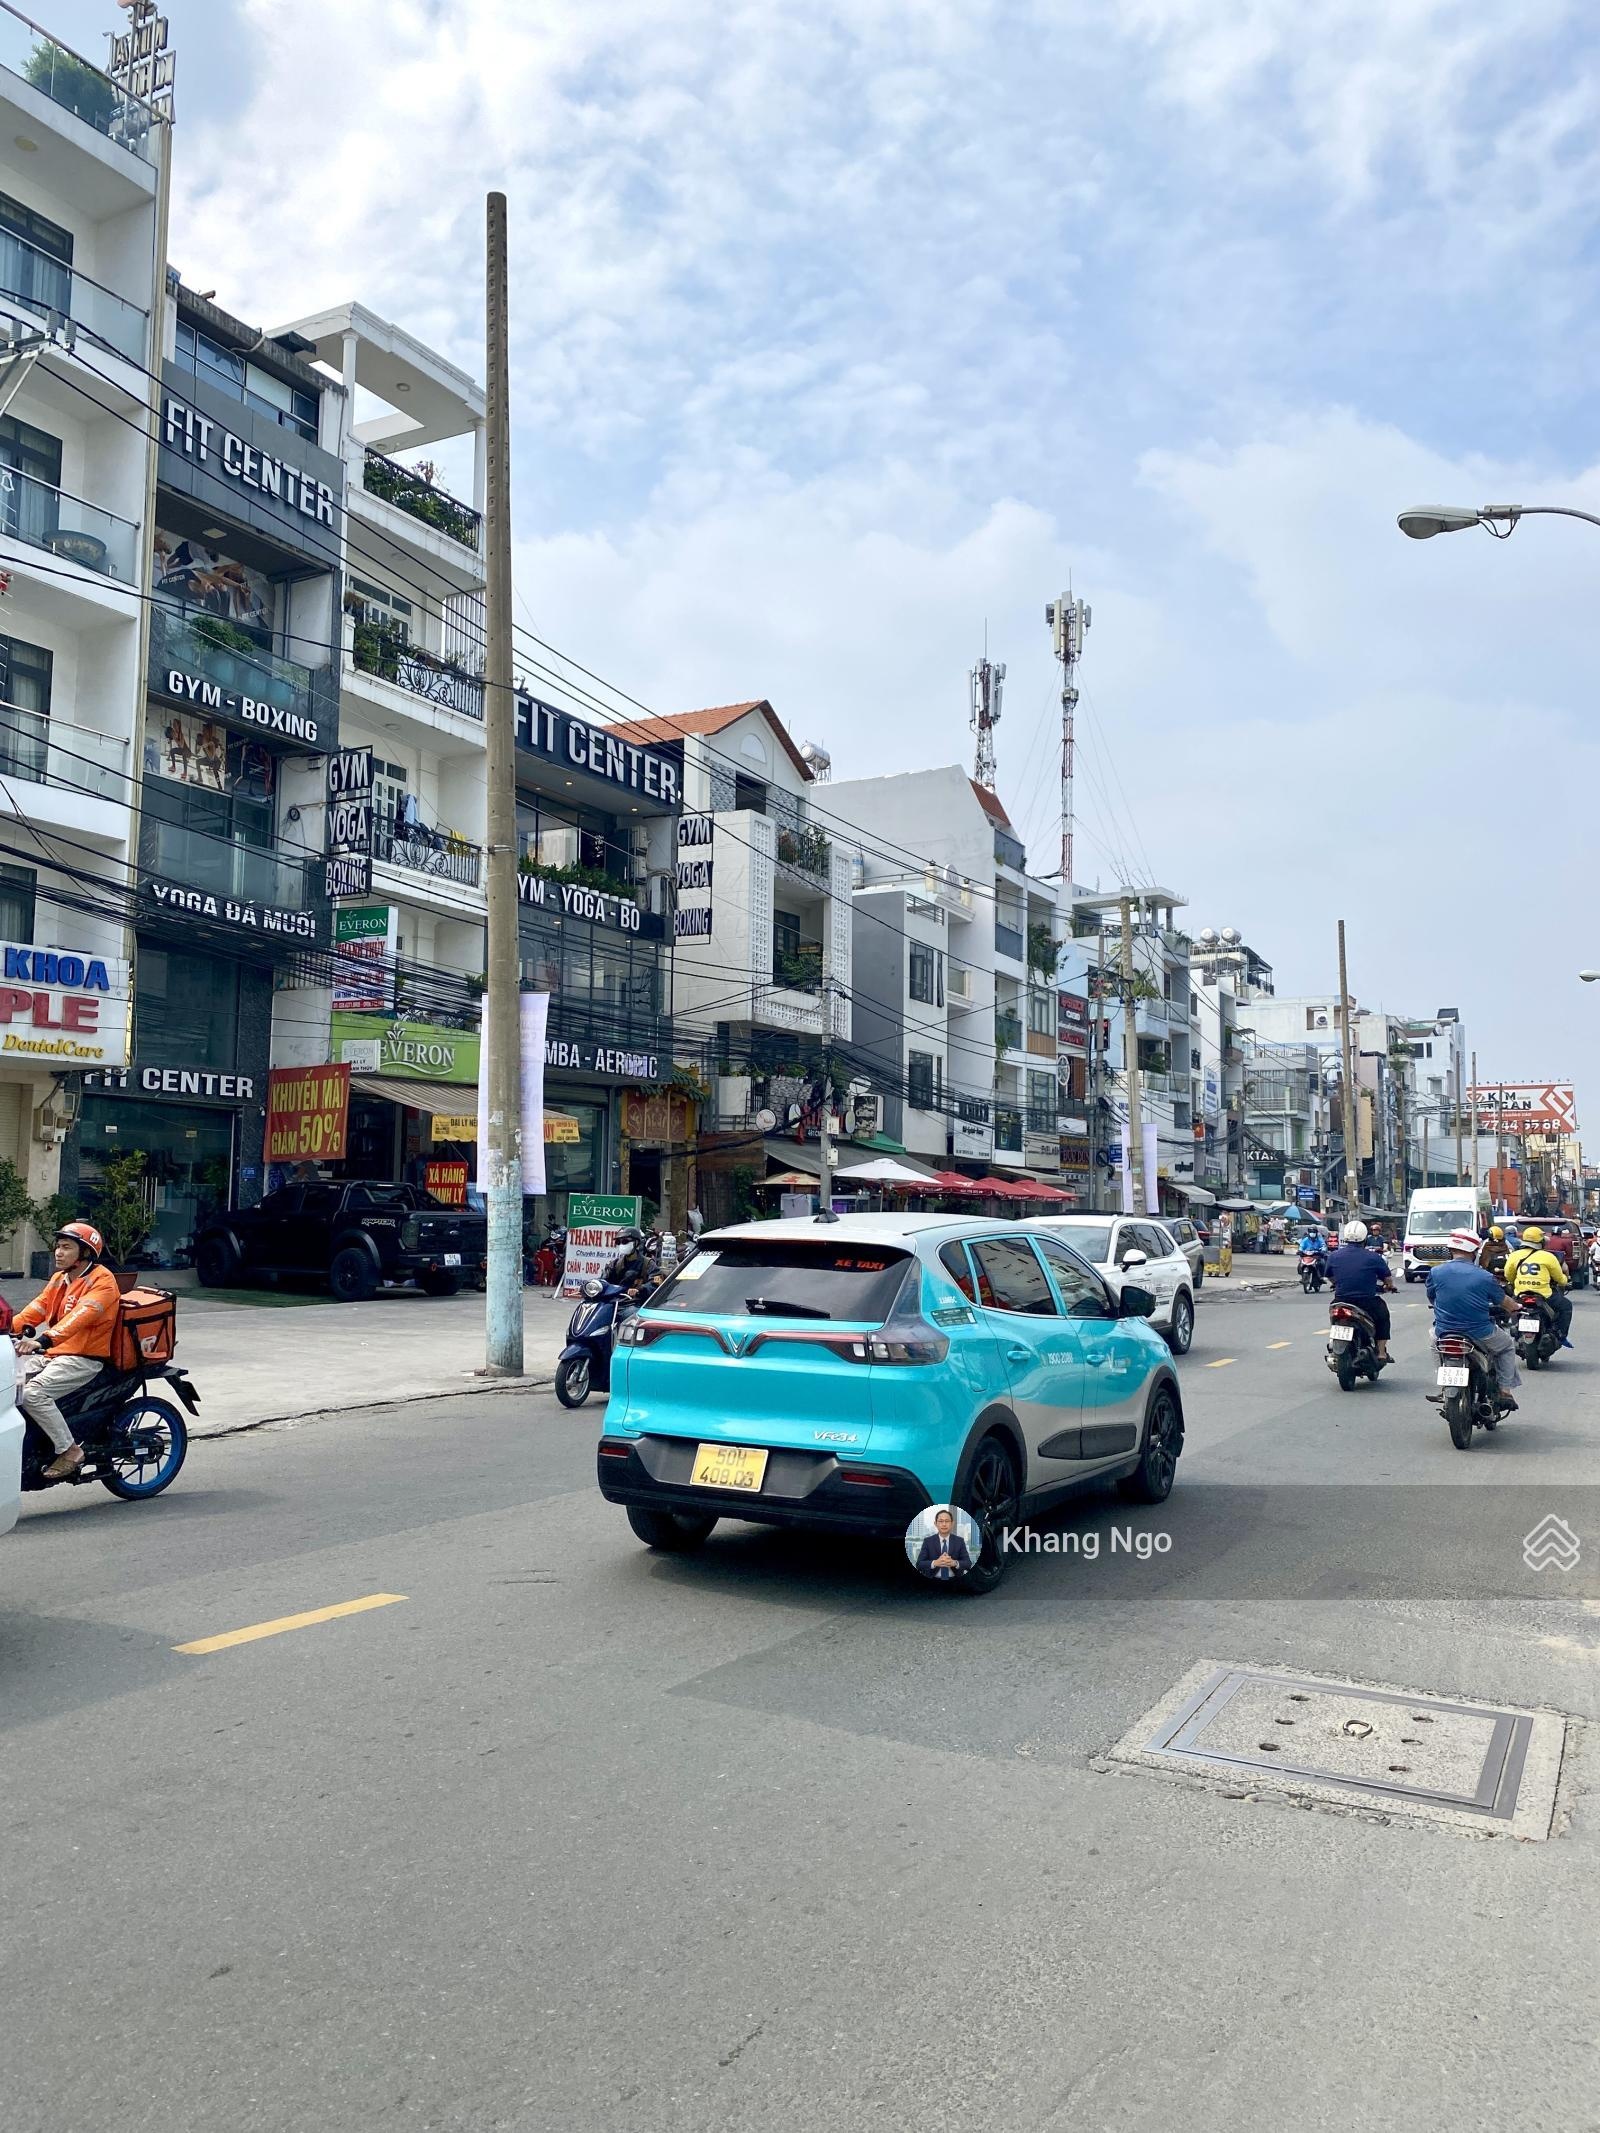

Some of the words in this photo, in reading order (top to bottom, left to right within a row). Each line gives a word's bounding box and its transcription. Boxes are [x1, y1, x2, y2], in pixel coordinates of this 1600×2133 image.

[167, 399, 213, 461] FIT
[224, 432, 333, 526] CENTER
[168, 670, 221, 708] GYM
[242, 696, 318, 742] BOXING
[513, 694, 560, 753] FIT
[568, 720, 677, 805] CENTER
[329, 752, 369, 792] GYM
[328, 807, 368, 844] YOGA
[676, 817, 711, 846] GYM
[325, 858, 367, 896] BOXING
[676, 860, 709, 889] YOGA
[153, 884, 218, 917] YOGA
[225, 900, 257, 926] ĐÁ
[263, 909, 316, 938] MUỐI
[517, 873, 545, 905] YM
[562, 886, 606, 922] YOGA
[620, 904, 641, 931] BO
[339, 917, 387, 931] EVERON
[674, 908, 709, 937] BOXING
[4, 947, 110, 991] KHOA
[0, 987, 99, 1034] PLE
[3, 1033, 104, 1059] DentalCare
[380, 1039, 456, 1068] EVERON
[594, 1048, 658, 1079] AEROBIC
[142, 1067, 254, 1098] CENTER
[272, 1069, 319, 1113] KHUYẾN
[1488, 1092, 1516, 1101] KM
[271, 1125, 298, 1155] GIẢM
[300, 1113, 341, 1154] 50%
[429, 1163, 440, 1184] XẢ
[441, 1165, 465, 1184] HÀNG
[454, 1183, 464, 1204] LÝ
[573, 1205, 634, 1219] EVERON
[569, 1228, 602, 1248] THANH
[604, 1230, 619, 1248] TH
[585, 1262, 600, 1275] DRAP
[834, 1258, 852, 1268] XE
[854, 1259, 886, 1271] TAXI
[813, 1430, 858, 1443] VFe34
[717, 1450, 748, 1467] 50H
[699, 1466, 755, 1488] 408.03
